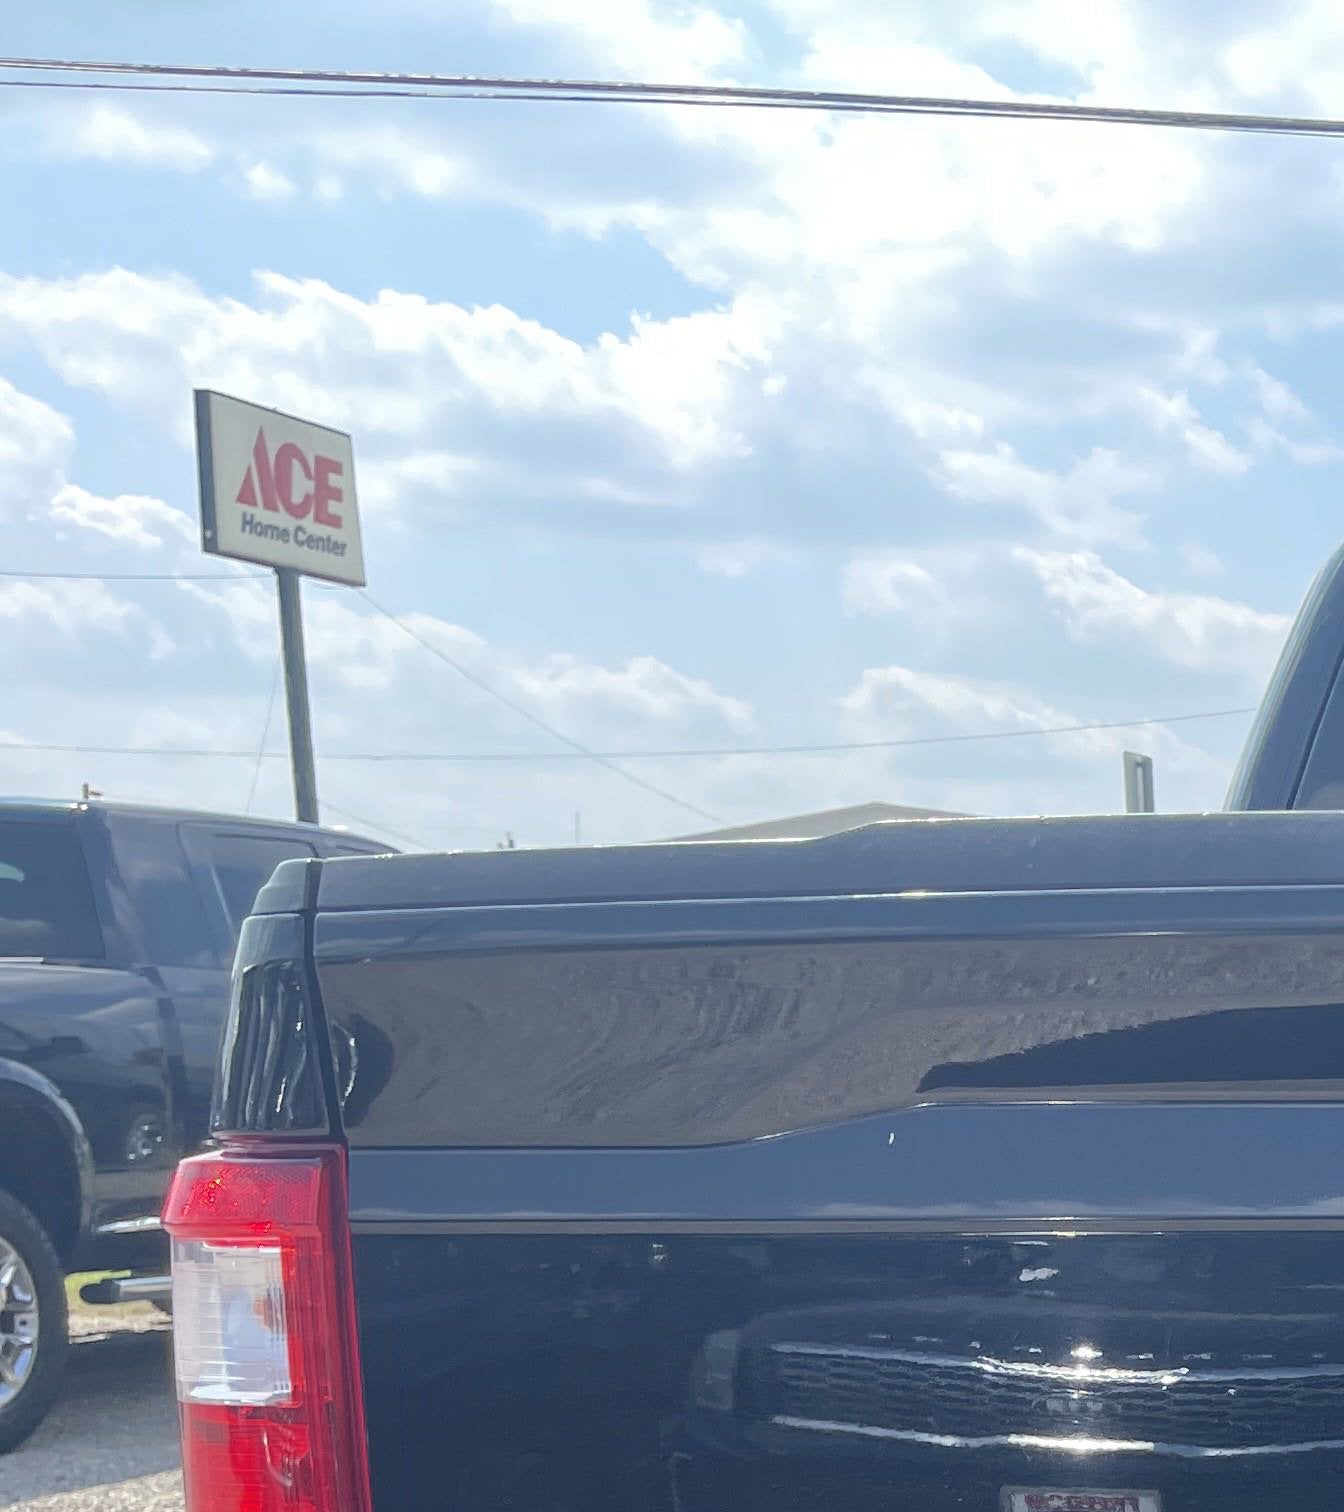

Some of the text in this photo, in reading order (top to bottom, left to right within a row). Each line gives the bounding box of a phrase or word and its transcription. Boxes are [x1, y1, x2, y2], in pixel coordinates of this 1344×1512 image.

[235, 425, 343, 530] ACE
[241, 511, 347, 557] Home Center
